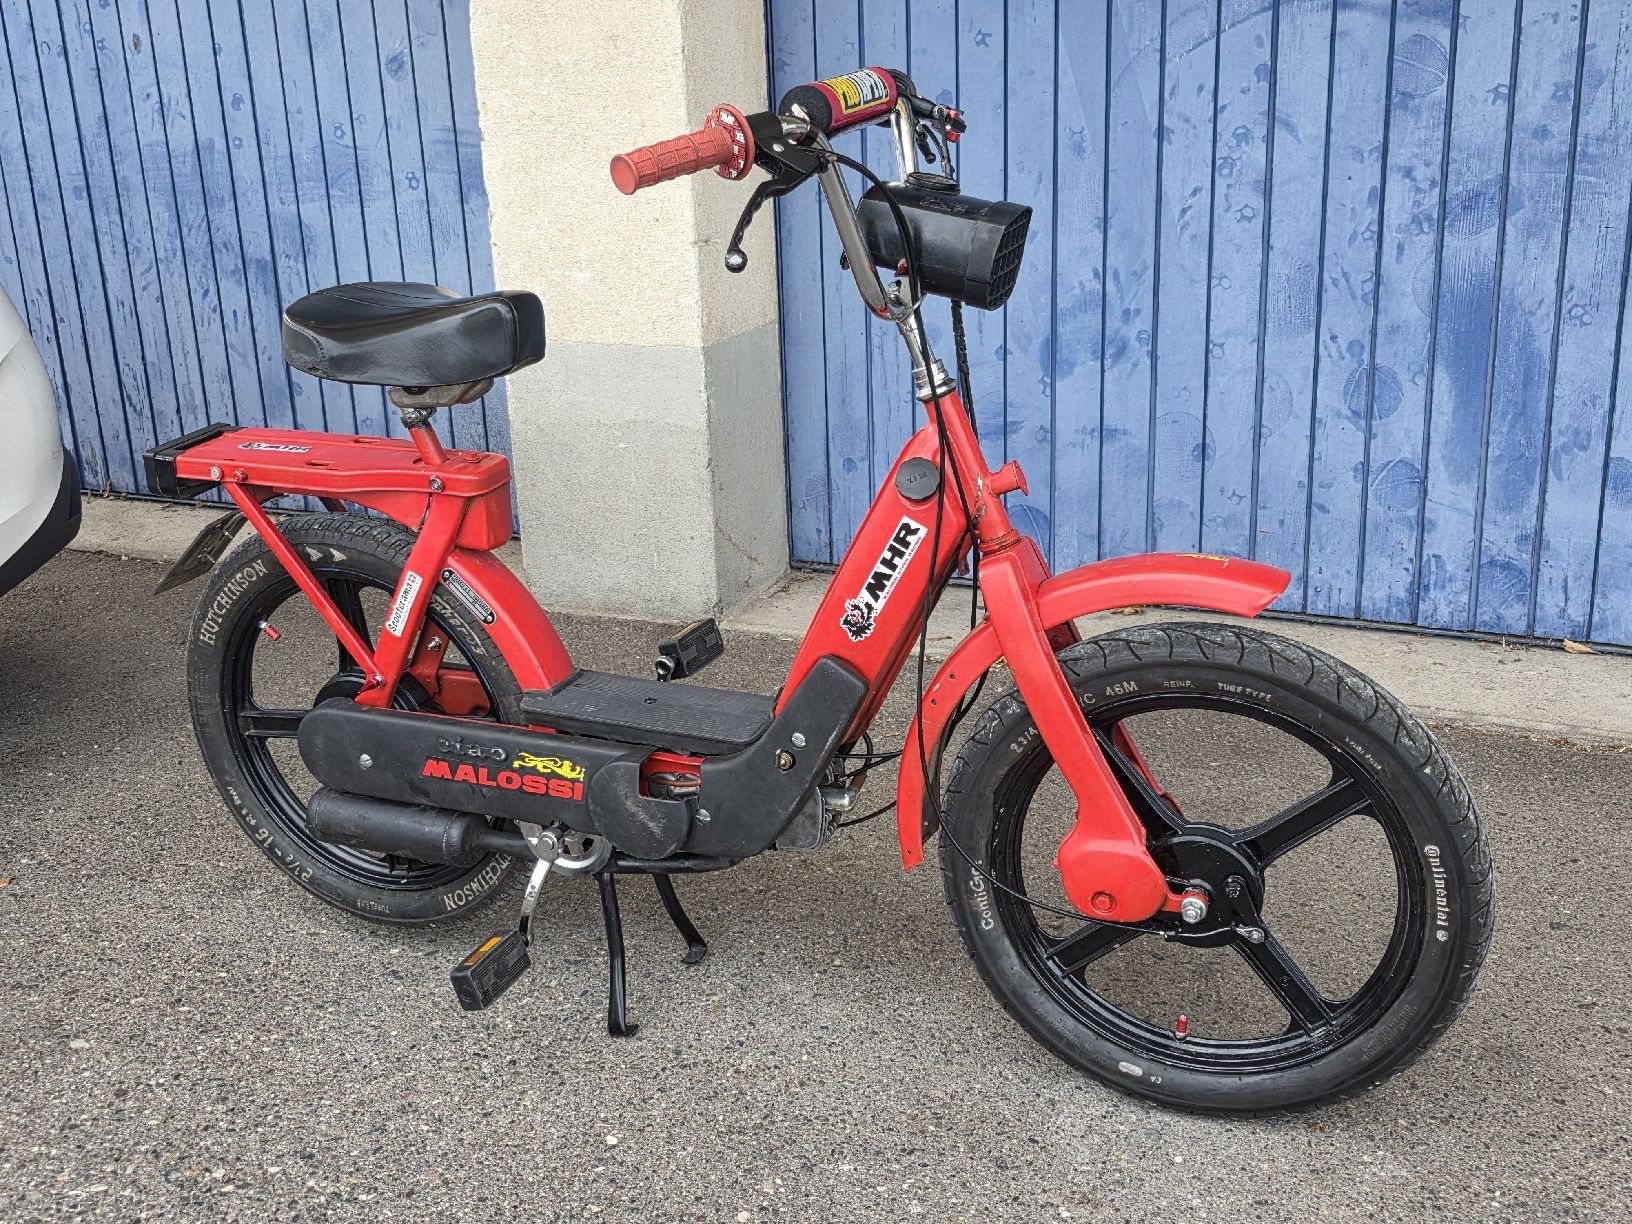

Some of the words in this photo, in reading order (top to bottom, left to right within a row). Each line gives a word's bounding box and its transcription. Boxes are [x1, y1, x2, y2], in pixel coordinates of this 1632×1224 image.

[864, 522, 921, 603] MHR
[200, 559, 269, 646] HUTCHINSON
[388, 582, 414, 633] Scooterama
[1246, 688, 1272, 702] TYPE
[421, 758, 584, 801] MALOSSI
